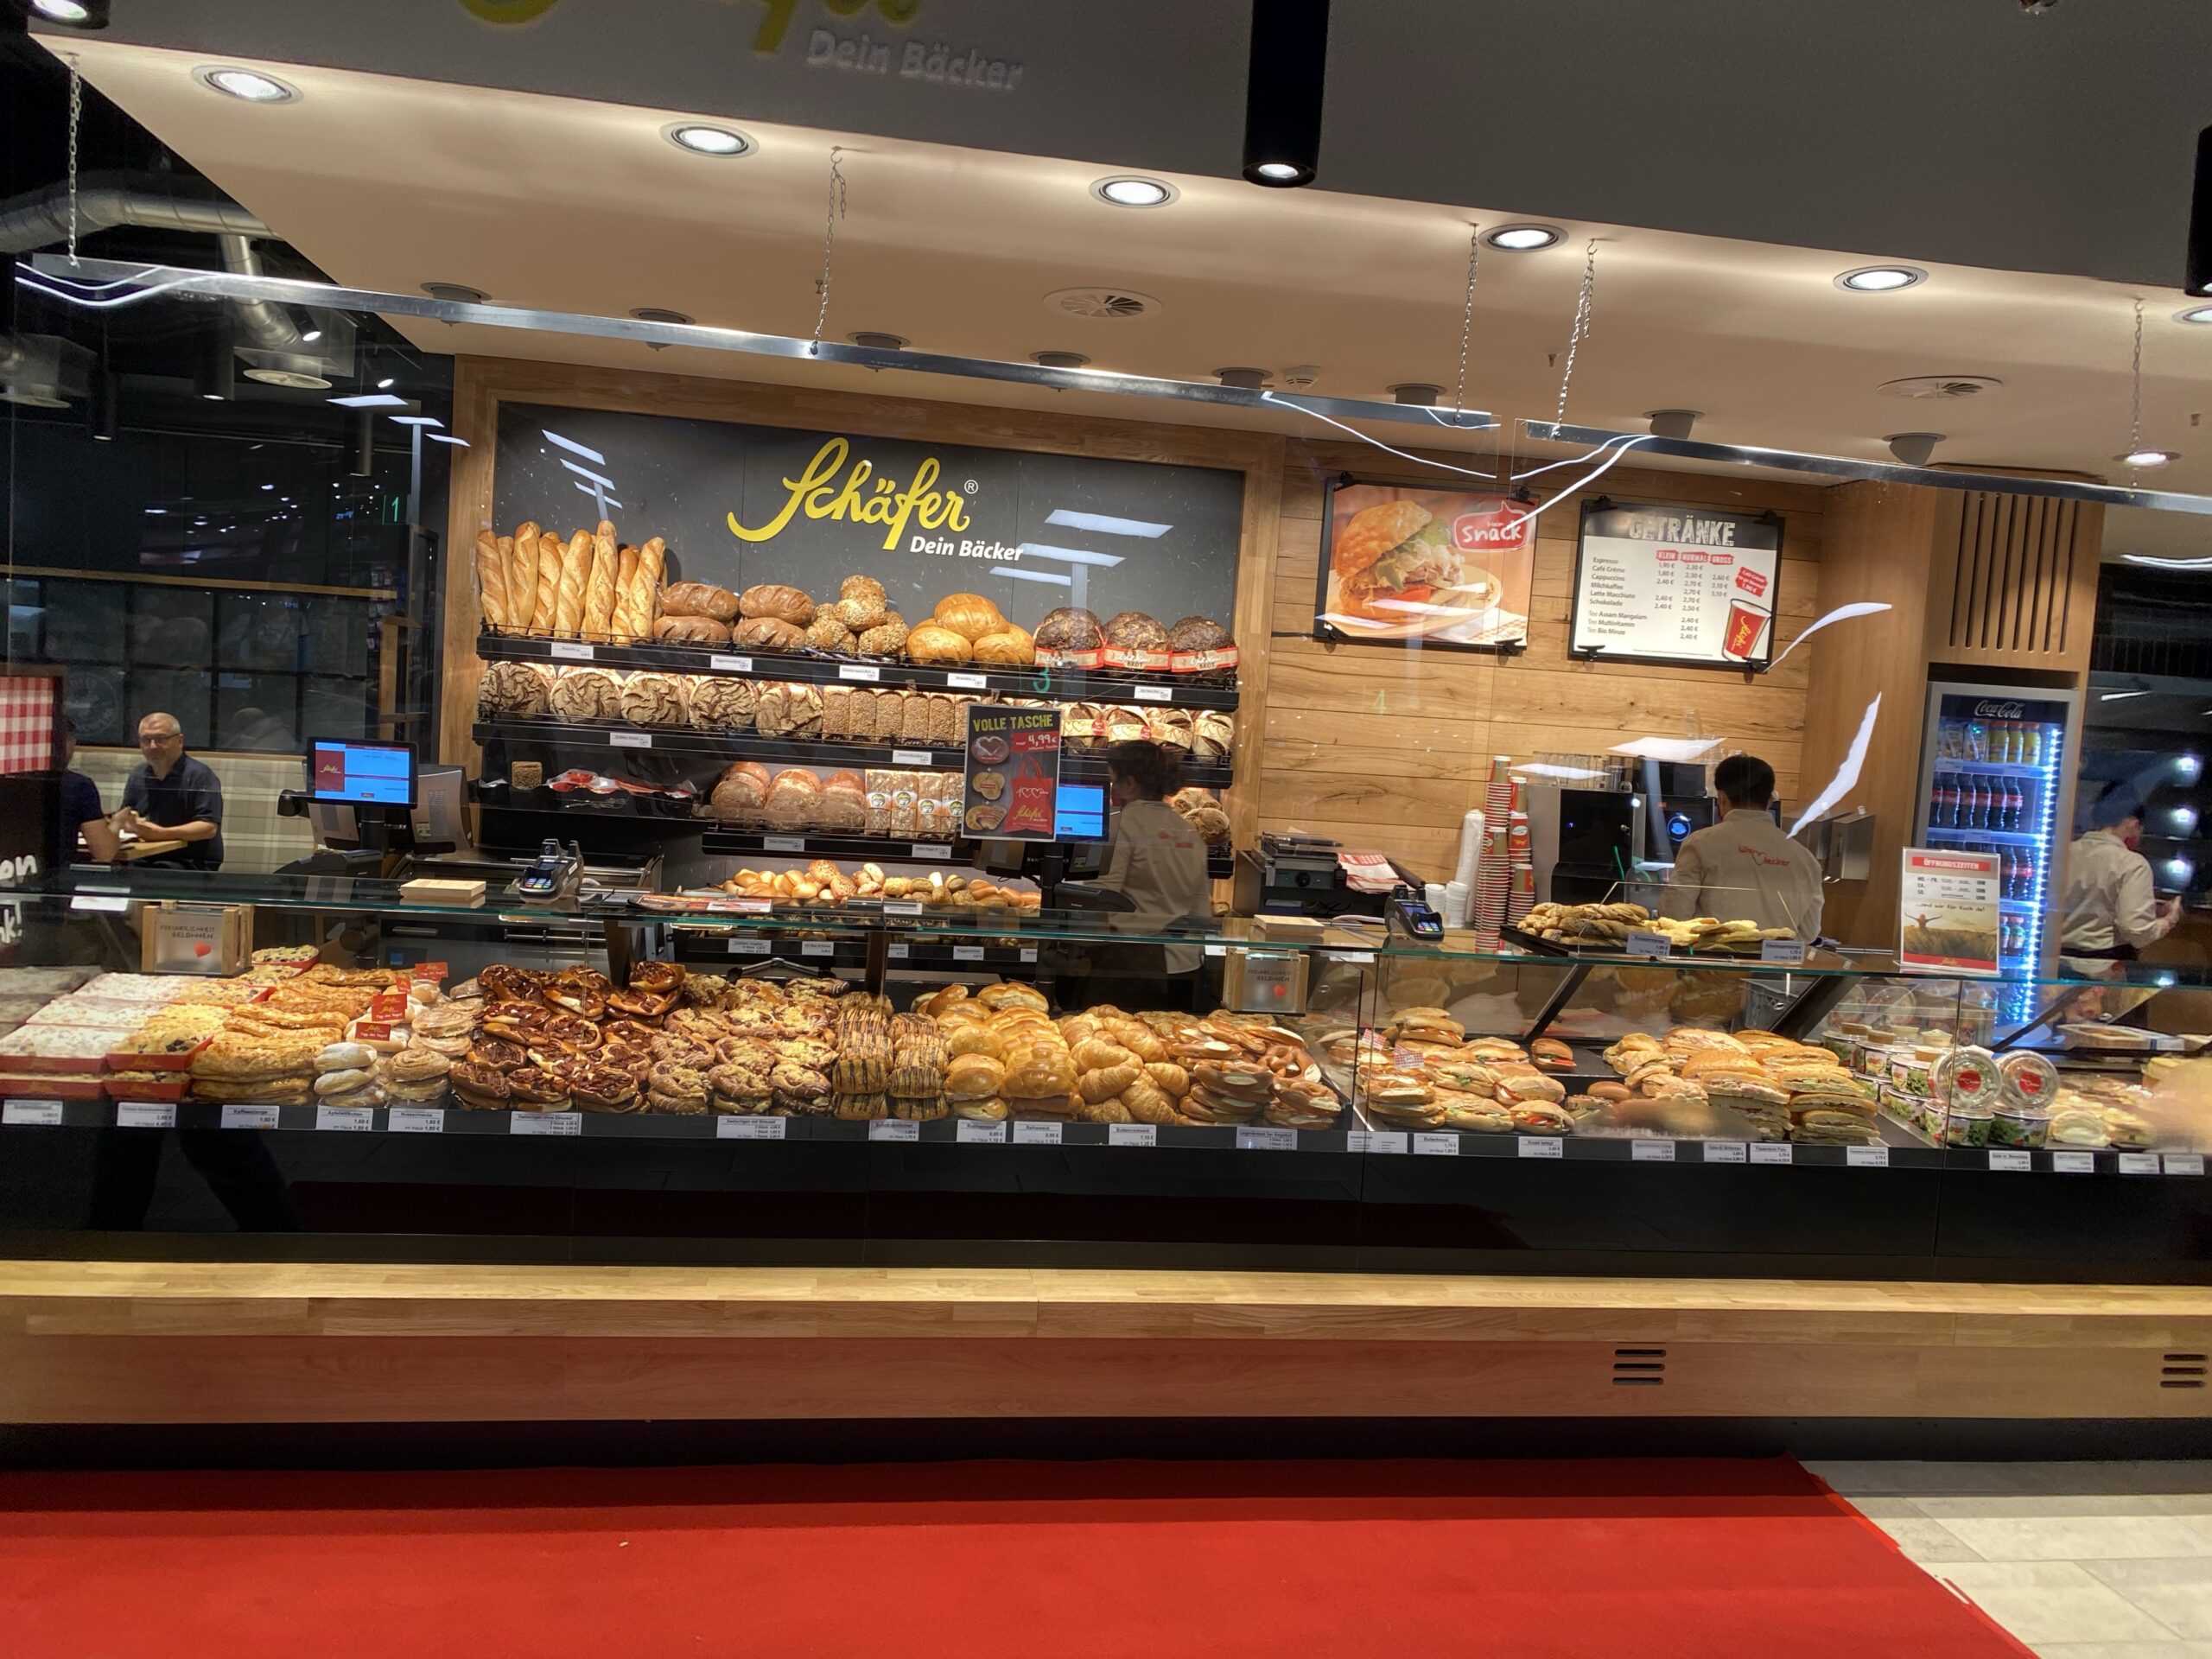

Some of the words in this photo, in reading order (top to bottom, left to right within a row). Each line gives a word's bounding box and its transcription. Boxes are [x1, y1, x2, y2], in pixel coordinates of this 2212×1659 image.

[805, 29, 890, 75] Dein
[899, 41, 1025, 91] Bäcker
[727, 436, 971, 551] Schäfer
[1461, 519, 1522, 543] Snack
[1628, 515, 1736, 547] GETRÄNKE
[910, 535, 955, 557] Dein
[958, 539, 1025, 563] Bäcker
[1658, 551, 1676, 560] KLEIN
[1682, 553, 1707, 563] NORMAL
[1591, 582, 1624, 590] Milchkaffee
[1589, 598, 1623, 607] Schokolade
[973, 717, 1007, 733] VOLLE
[1009, 714, 1053, 729] TASCHE
